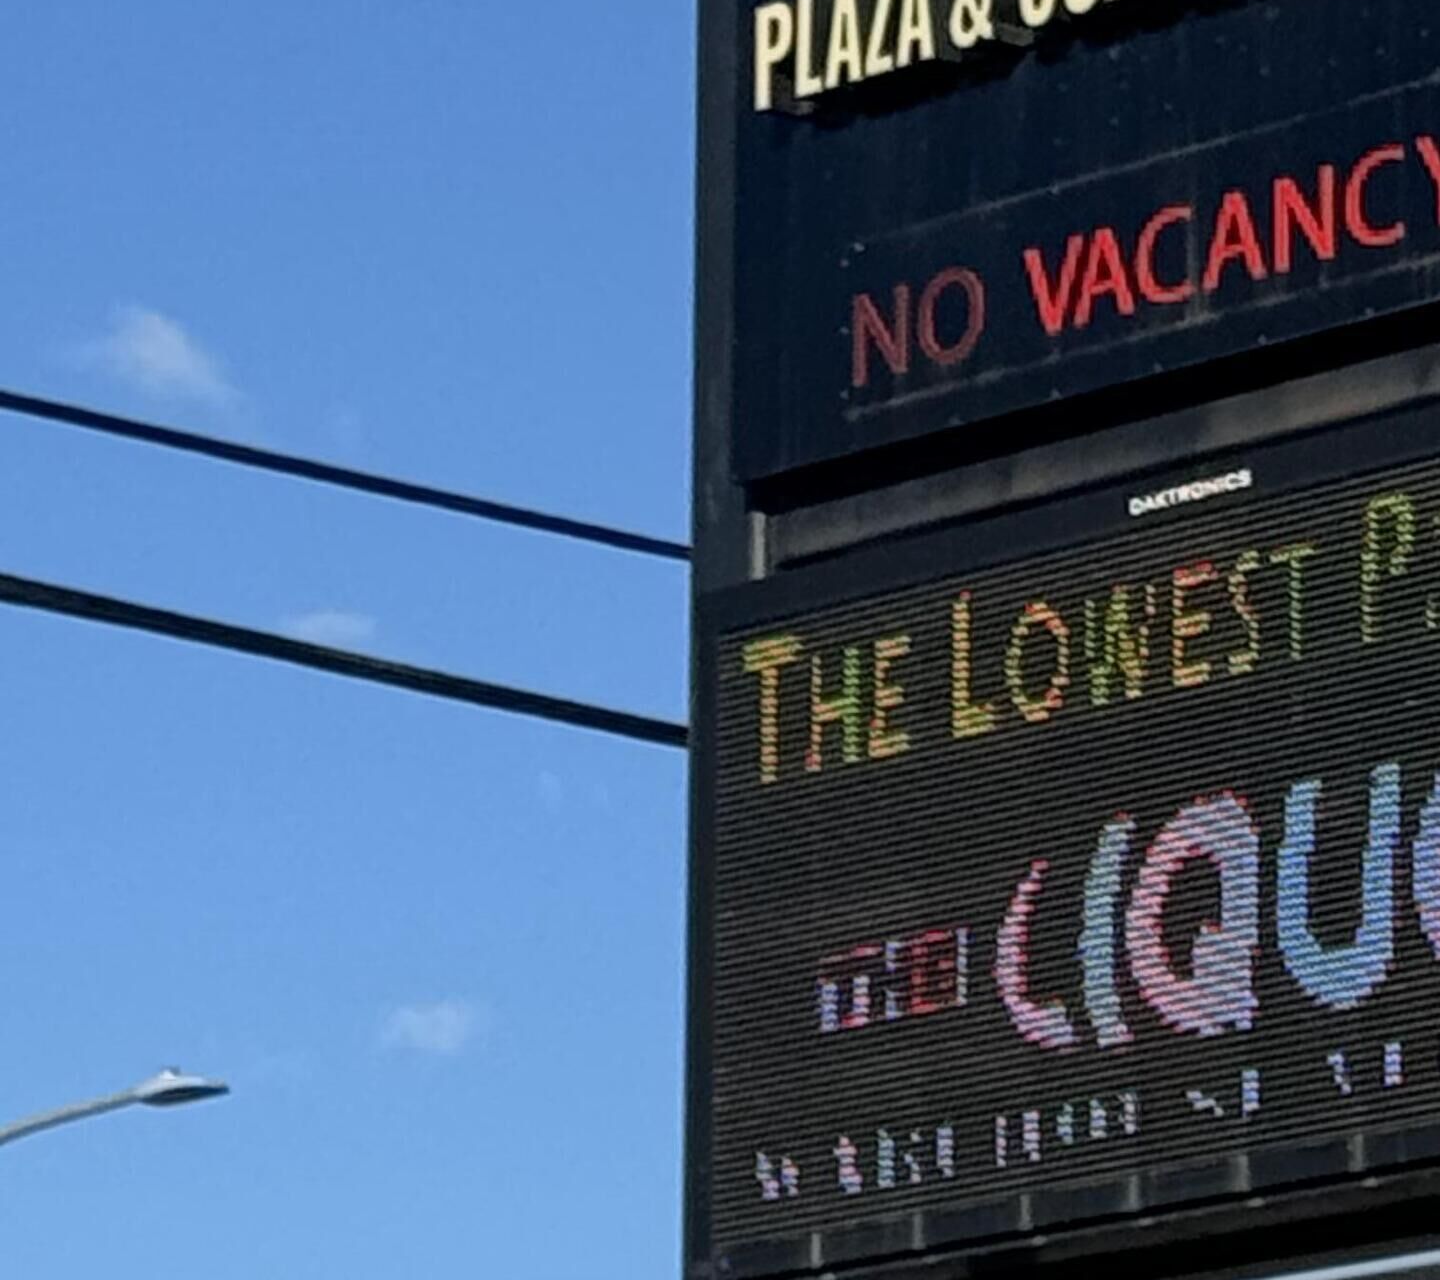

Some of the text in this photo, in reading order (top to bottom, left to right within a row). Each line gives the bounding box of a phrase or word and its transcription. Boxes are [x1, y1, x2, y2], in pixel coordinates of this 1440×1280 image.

[849, 265, 986, 387] NO
[741, 634, 912, 784] THE
[951, 542, 1316, 738] LOWEST
